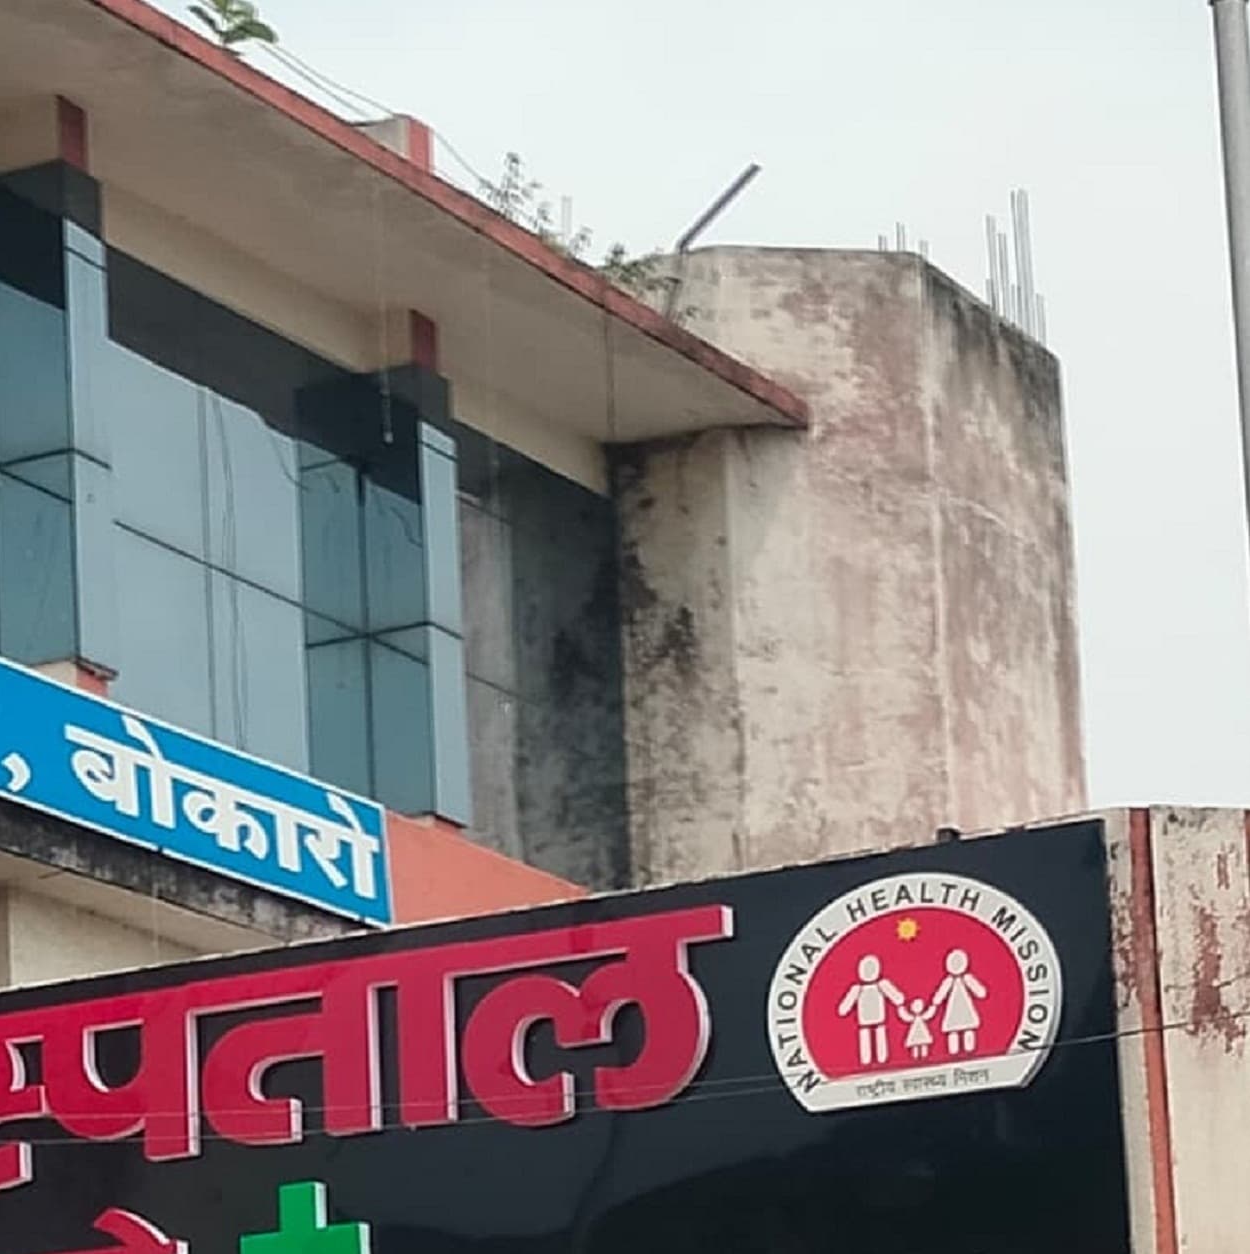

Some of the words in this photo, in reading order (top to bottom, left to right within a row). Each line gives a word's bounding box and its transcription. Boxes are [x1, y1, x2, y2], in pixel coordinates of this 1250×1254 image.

[64, 714, 379, 899] बोकारो
[777, 926, 838, 1094] NATIONAL
[846, 882, 981, 923] HEALTH
[990, 906, 1050, 1051] MISSION
